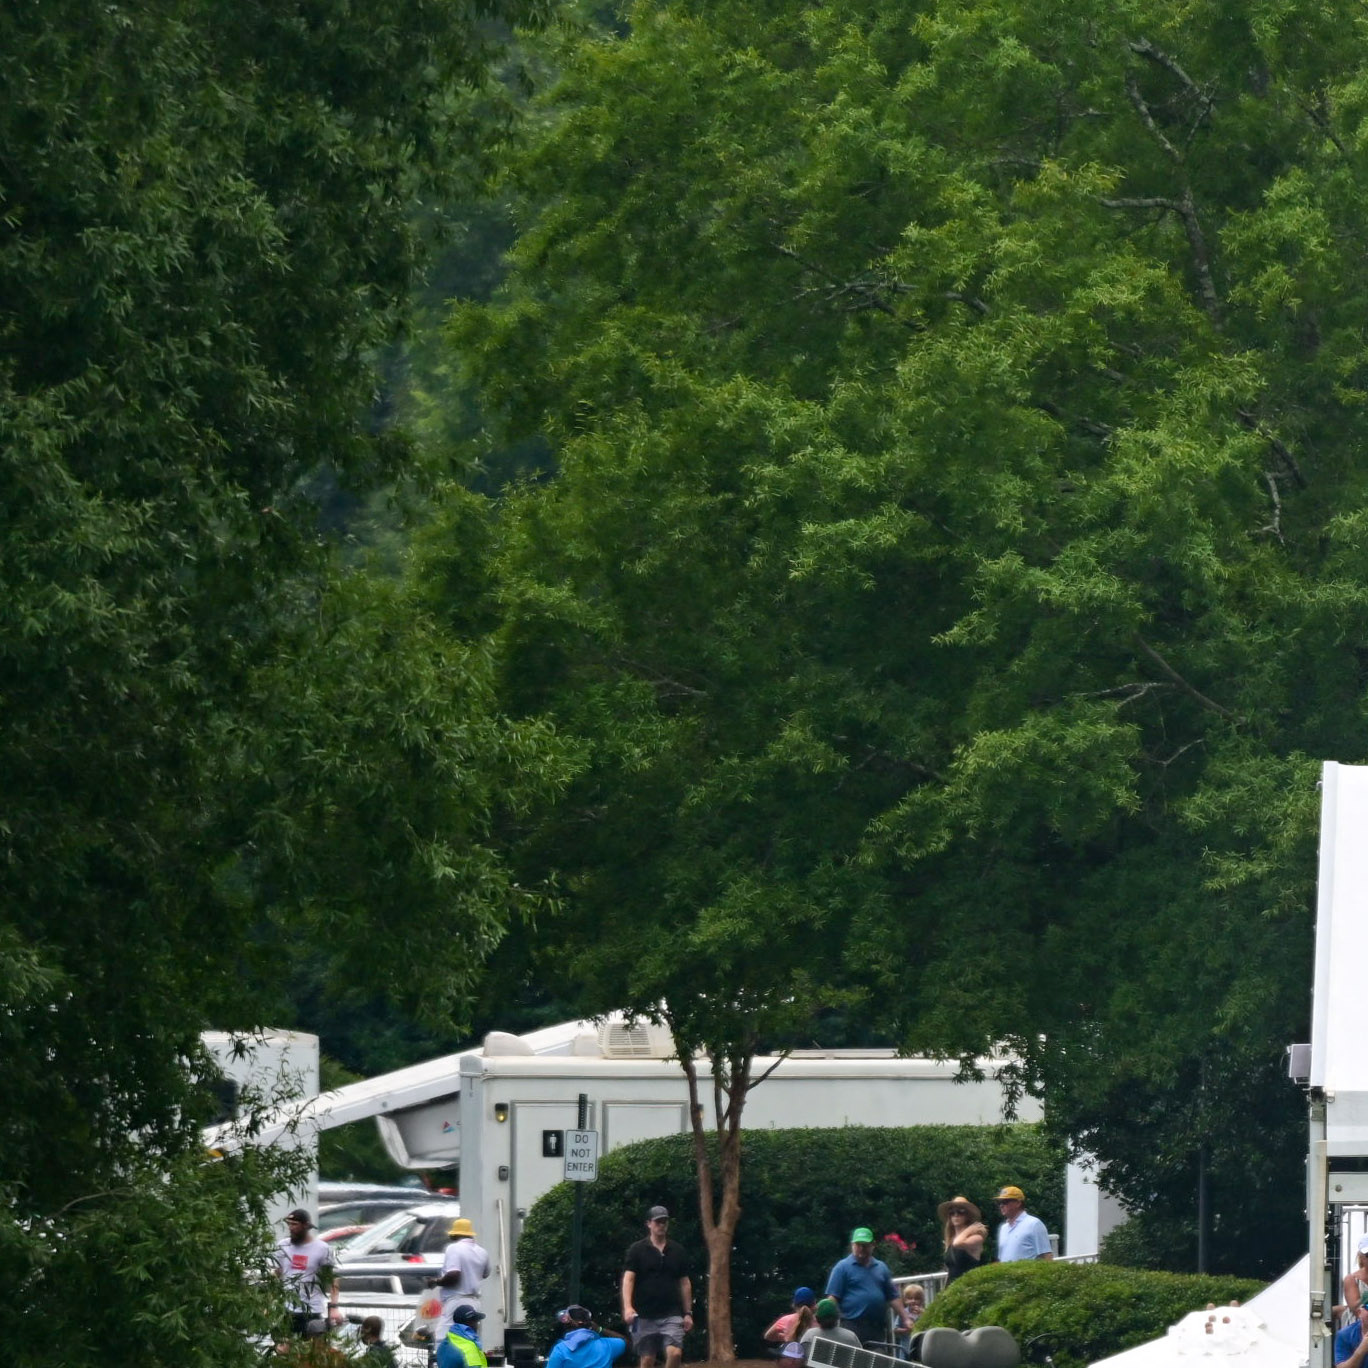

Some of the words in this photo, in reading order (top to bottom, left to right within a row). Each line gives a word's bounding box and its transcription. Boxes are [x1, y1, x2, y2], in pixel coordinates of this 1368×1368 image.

[575, 1135, 588, 1143] DO
[571, 1149, 591, 1157] NOT
[567, 1163, 594, 1172] ENTER
